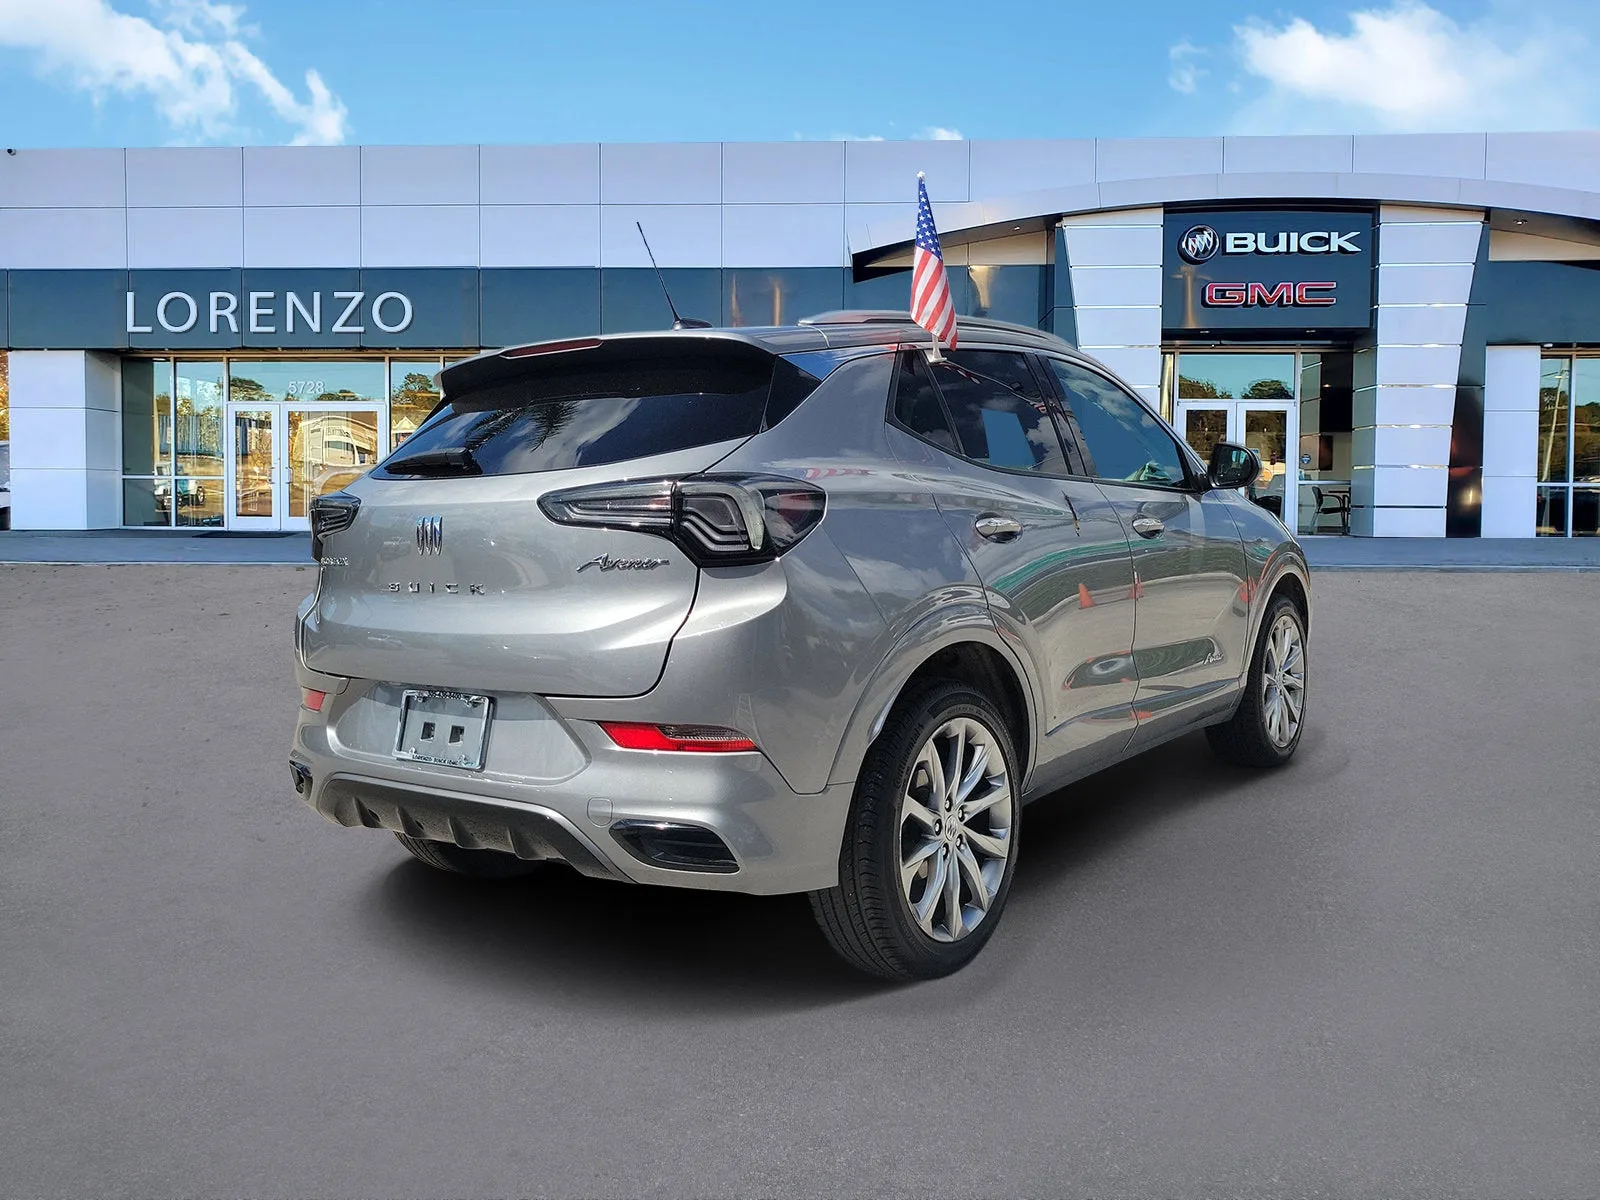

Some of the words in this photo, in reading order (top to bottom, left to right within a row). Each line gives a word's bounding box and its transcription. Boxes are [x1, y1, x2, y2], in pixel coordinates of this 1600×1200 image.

[1225, 231, 1362, 254] BUICK
[1205, 281, 1337, 305] GMC
[126, 291, 413, 333] LORENZO
[288, 380, 325, 394] 5728
[576, 552, 670, 573] Avenir
[388, 581, 485, 595] BUICK
